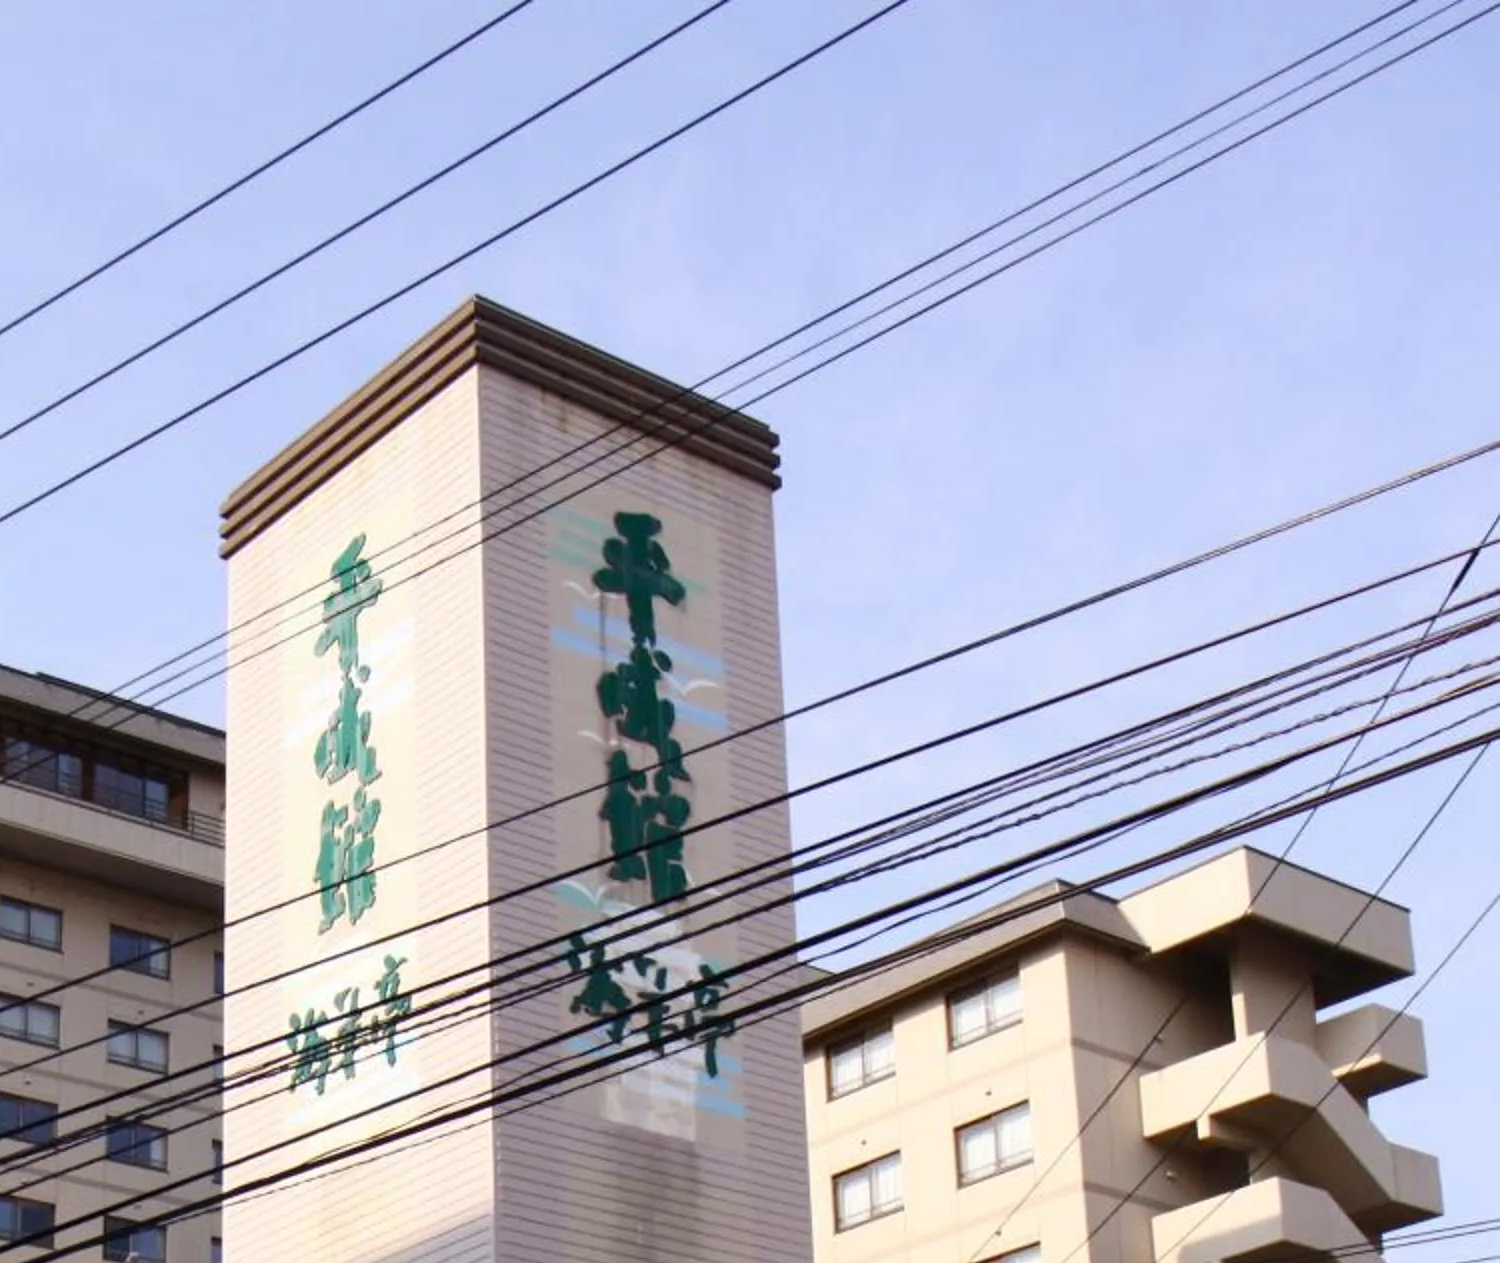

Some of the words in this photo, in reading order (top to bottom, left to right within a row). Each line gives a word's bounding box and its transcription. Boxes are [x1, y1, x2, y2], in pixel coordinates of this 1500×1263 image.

[313, 533, 383, 935] 平成館
[592, 511, 692, 902] 平成館
